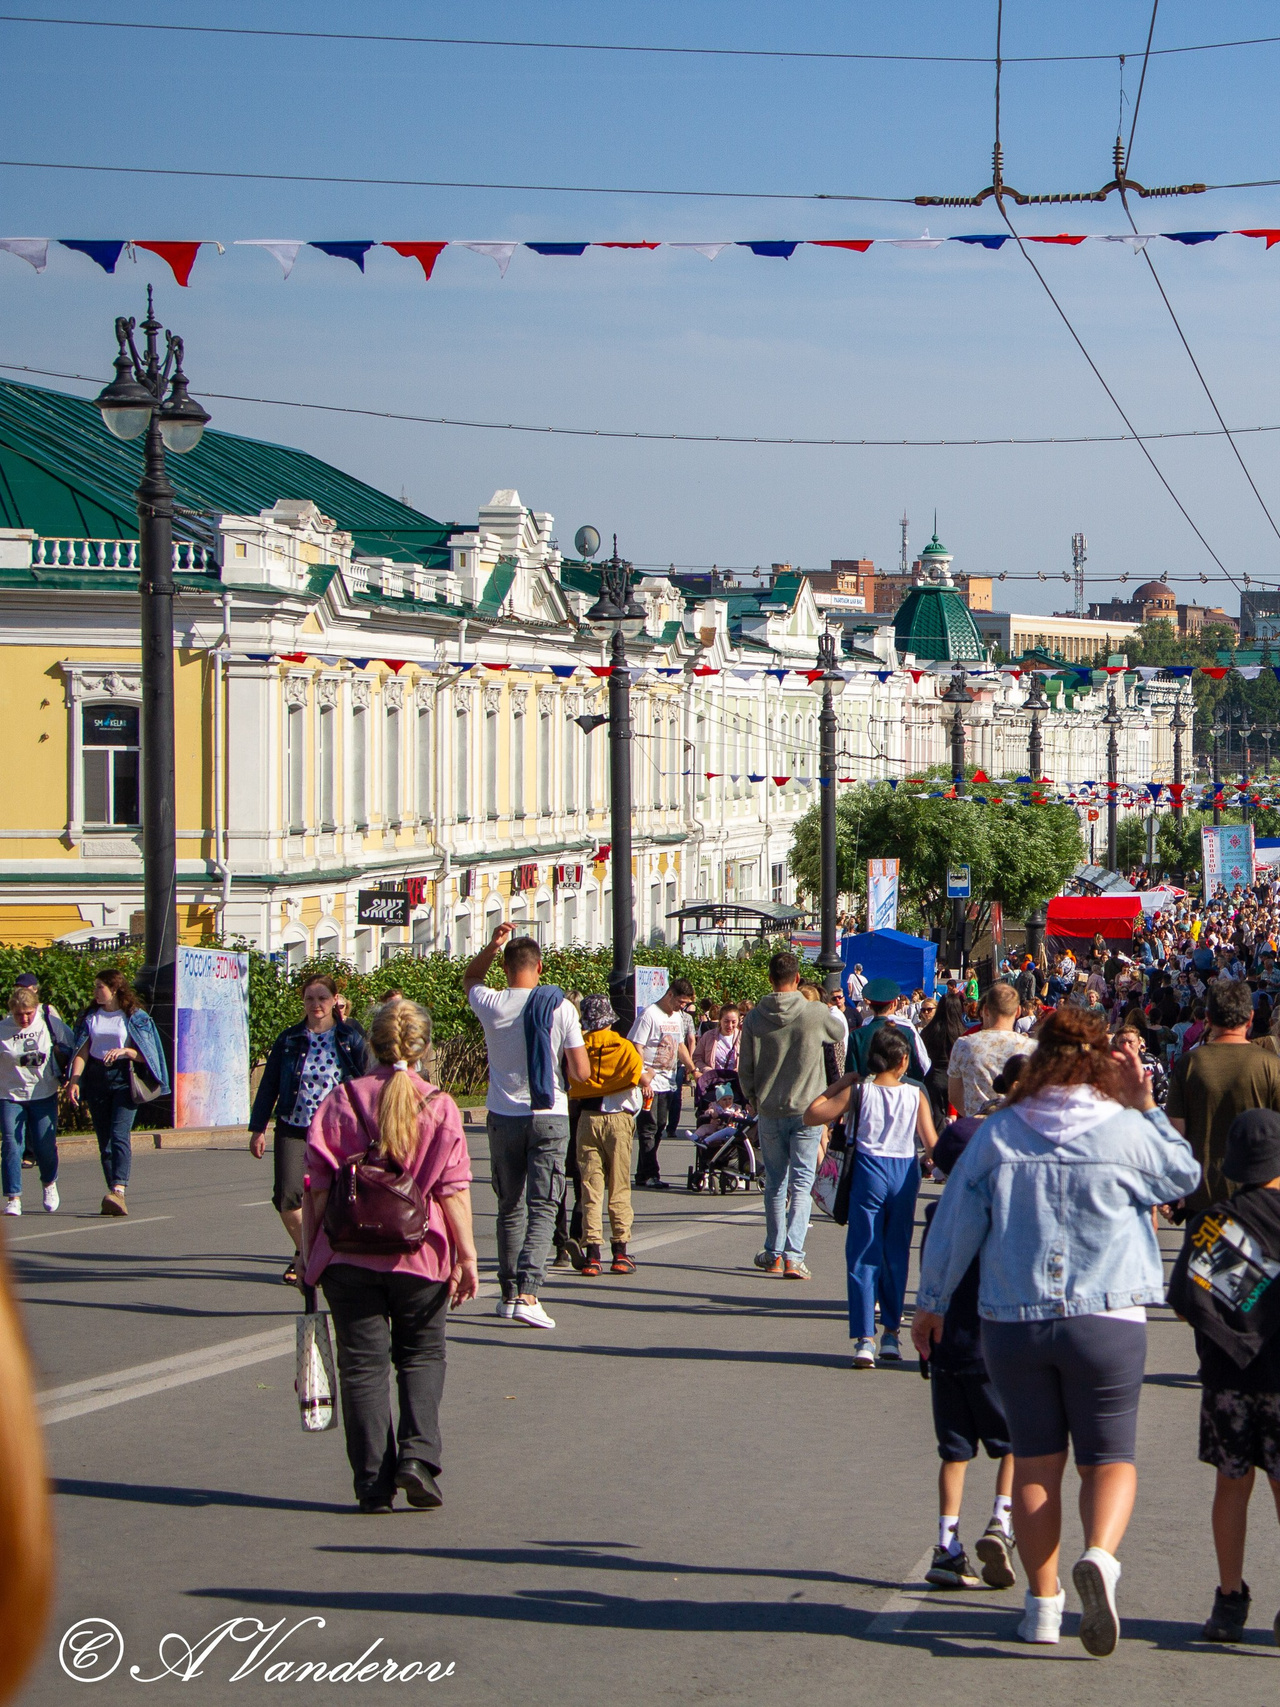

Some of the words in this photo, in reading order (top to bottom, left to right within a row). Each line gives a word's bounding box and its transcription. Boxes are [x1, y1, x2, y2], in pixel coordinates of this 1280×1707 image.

[407, 876, 427, 906] KFC
[520, 863, 538, 891] KFC
[184, 951, 212, 977] РОССИЯ
[216, 955, 229, 979] ЭТО
[1241, 1277, 1272, 1313] TOKYO
